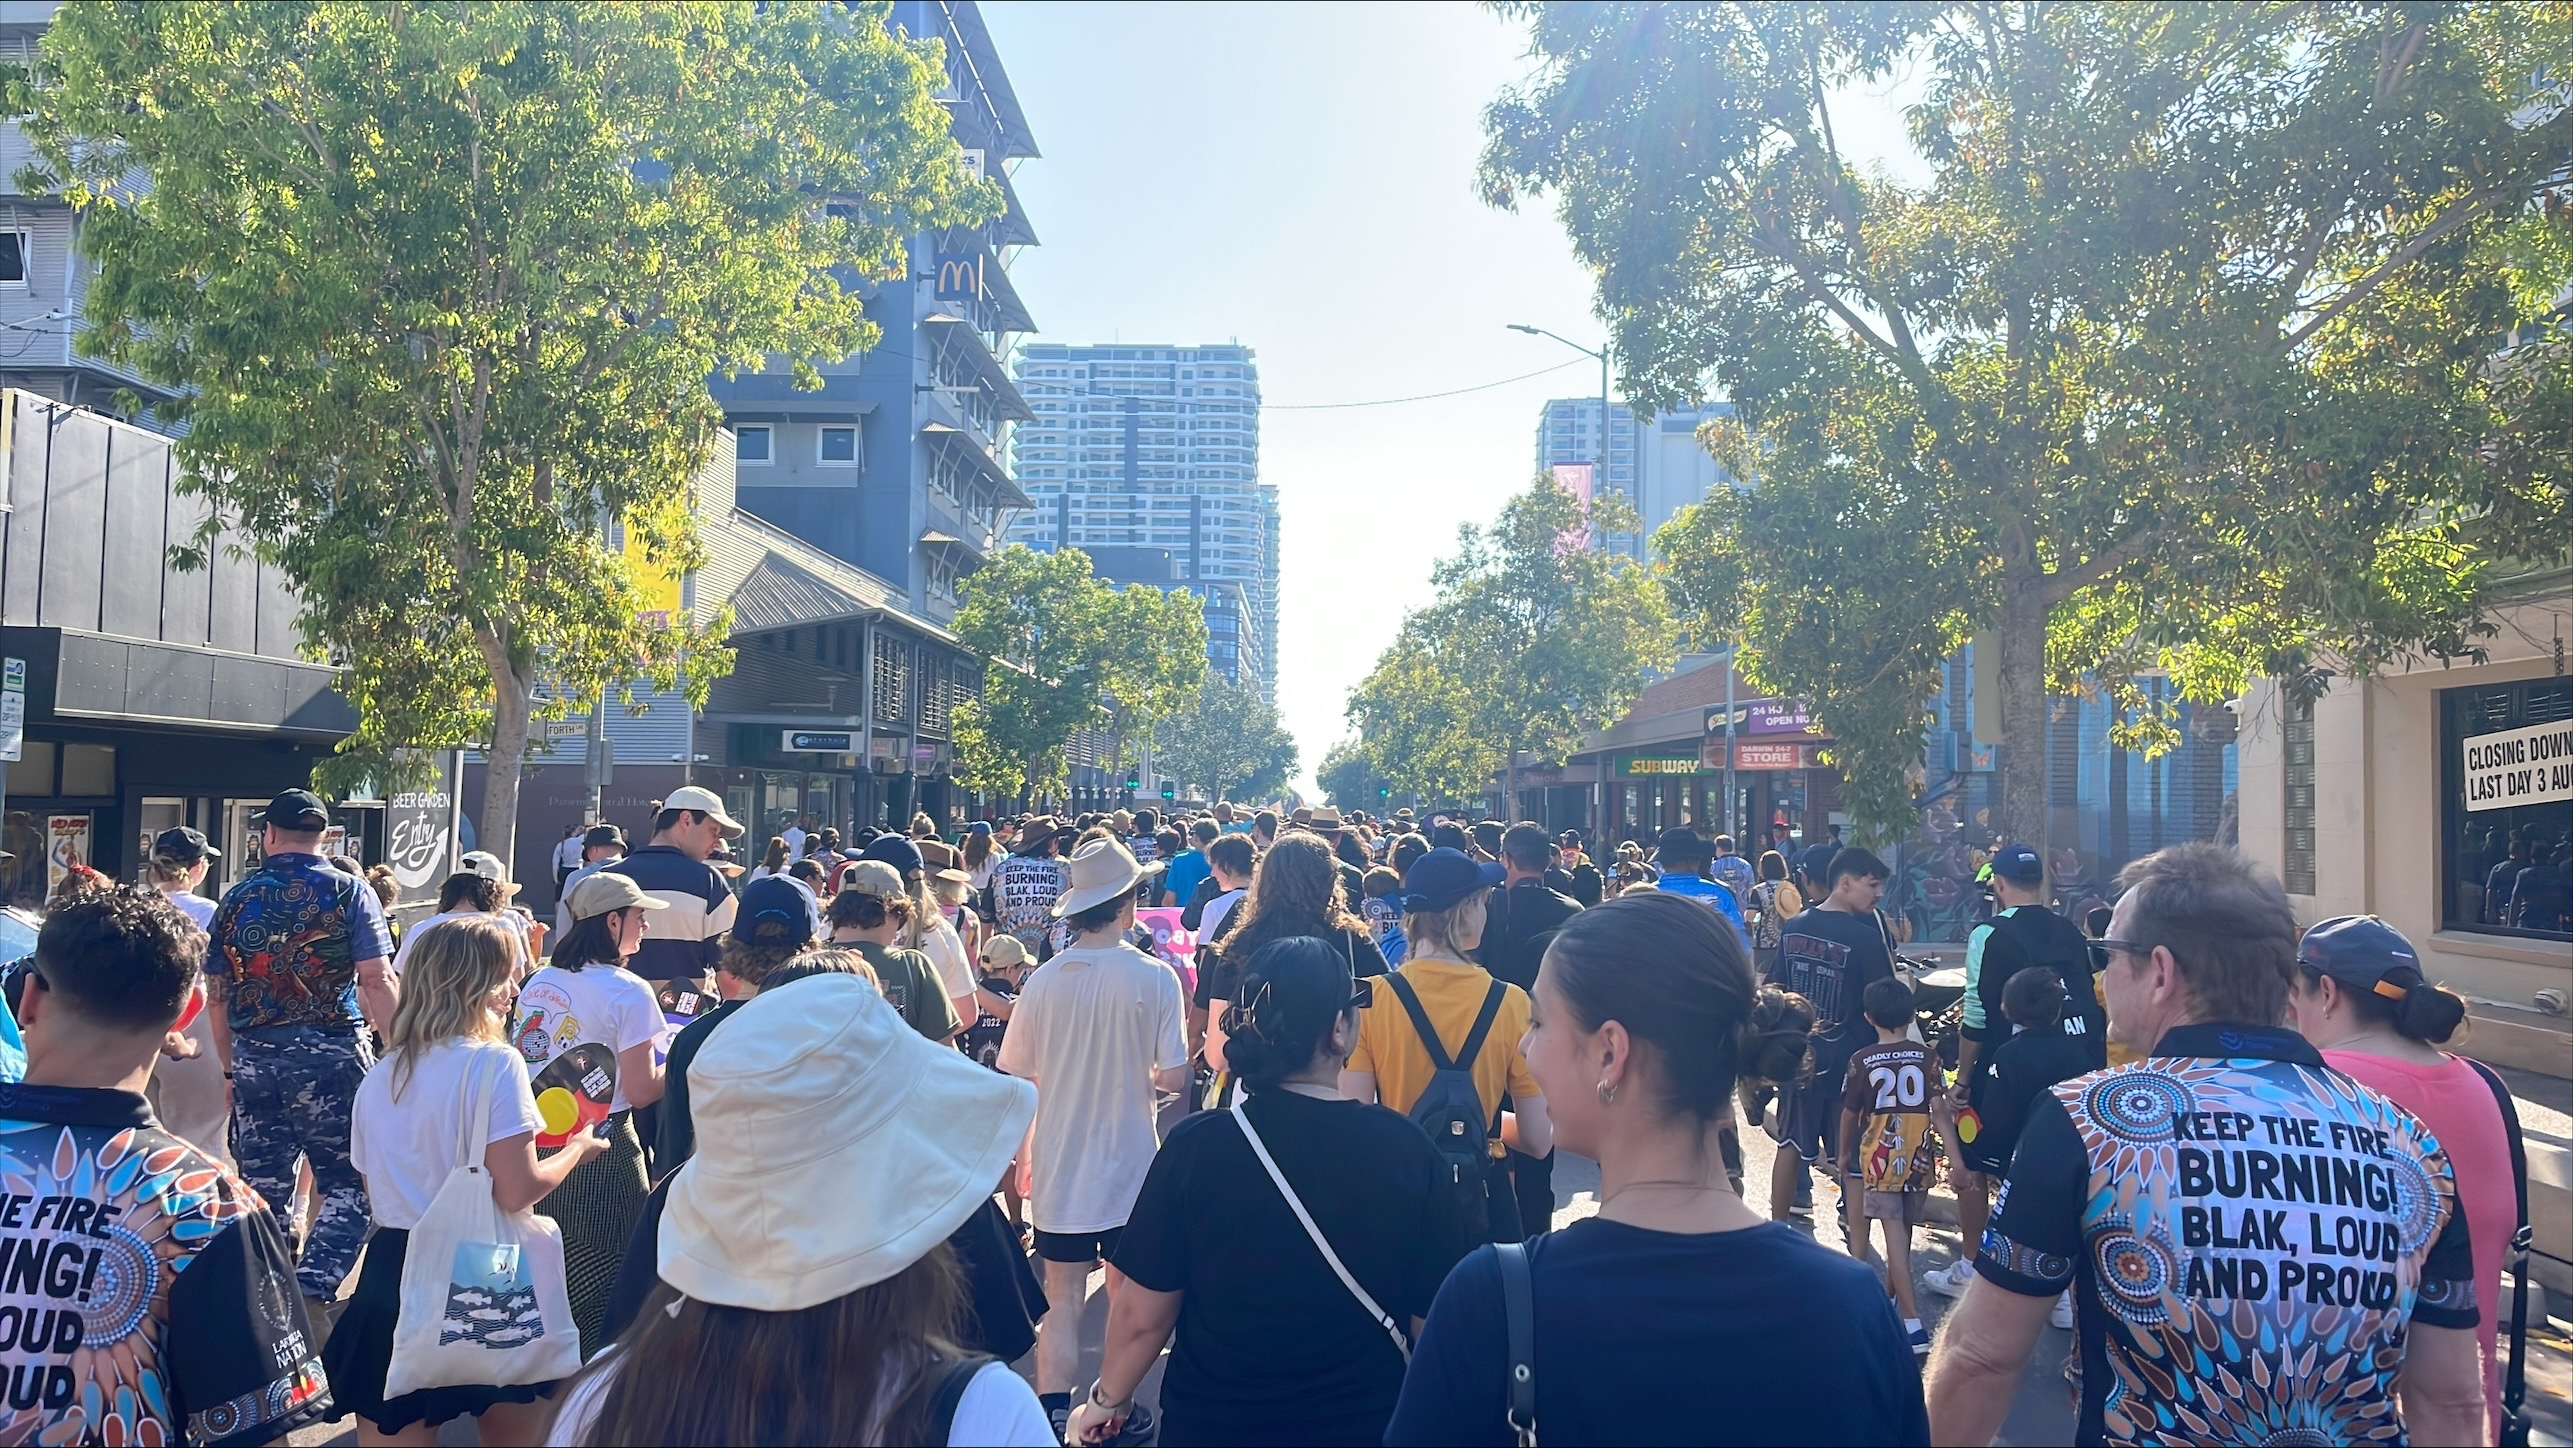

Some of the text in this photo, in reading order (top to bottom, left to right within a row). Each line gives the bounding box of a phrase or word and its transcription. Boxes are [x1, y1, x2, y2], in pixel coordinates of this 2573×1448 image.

[1752, 707, 1766, 716] 24
[1765, 716, 1793, 727] OPEN
[549, 725, 575, 735] FORTH
[1742, 753, 1791, 762] STORE
[2469, 731, 2573, 771] CLOSING DOWN
[1630, 760, 1699, 774] SUBWAY
[2470, 774, 2502, 801] LAST
[2508, 769, 2532, 796] DAY
[2538, 768, 2546, 792] 3
[393, 792, 450, 809] BEER GARDEN
[390, 810, 437, 867] Entry
[1041, 866, 1059, 874] FIRE
[1005, 874, 1058, 886] BURNING!
[1006, 886, 1058, 896] BLAK, LOUD
[1006, 896, 1056, 907] AND PROUD
[1863, 1051, 1891, 1065] DEADLY
[1892, 1050, 1924, 1060] CHOICES
[1868, 1065, 1925, 1109] 20
[2171, 1111, 2394, 1160] KEEP THE FIRE
[2177, 1147, 2399, 1215] BURNING!
[30, 1196, 122, 1240] FIRE
[2181, 1206, 2400, 1263] BLAK, LOUD
[2186, 1257, 2398, 1310] AND PROUD
